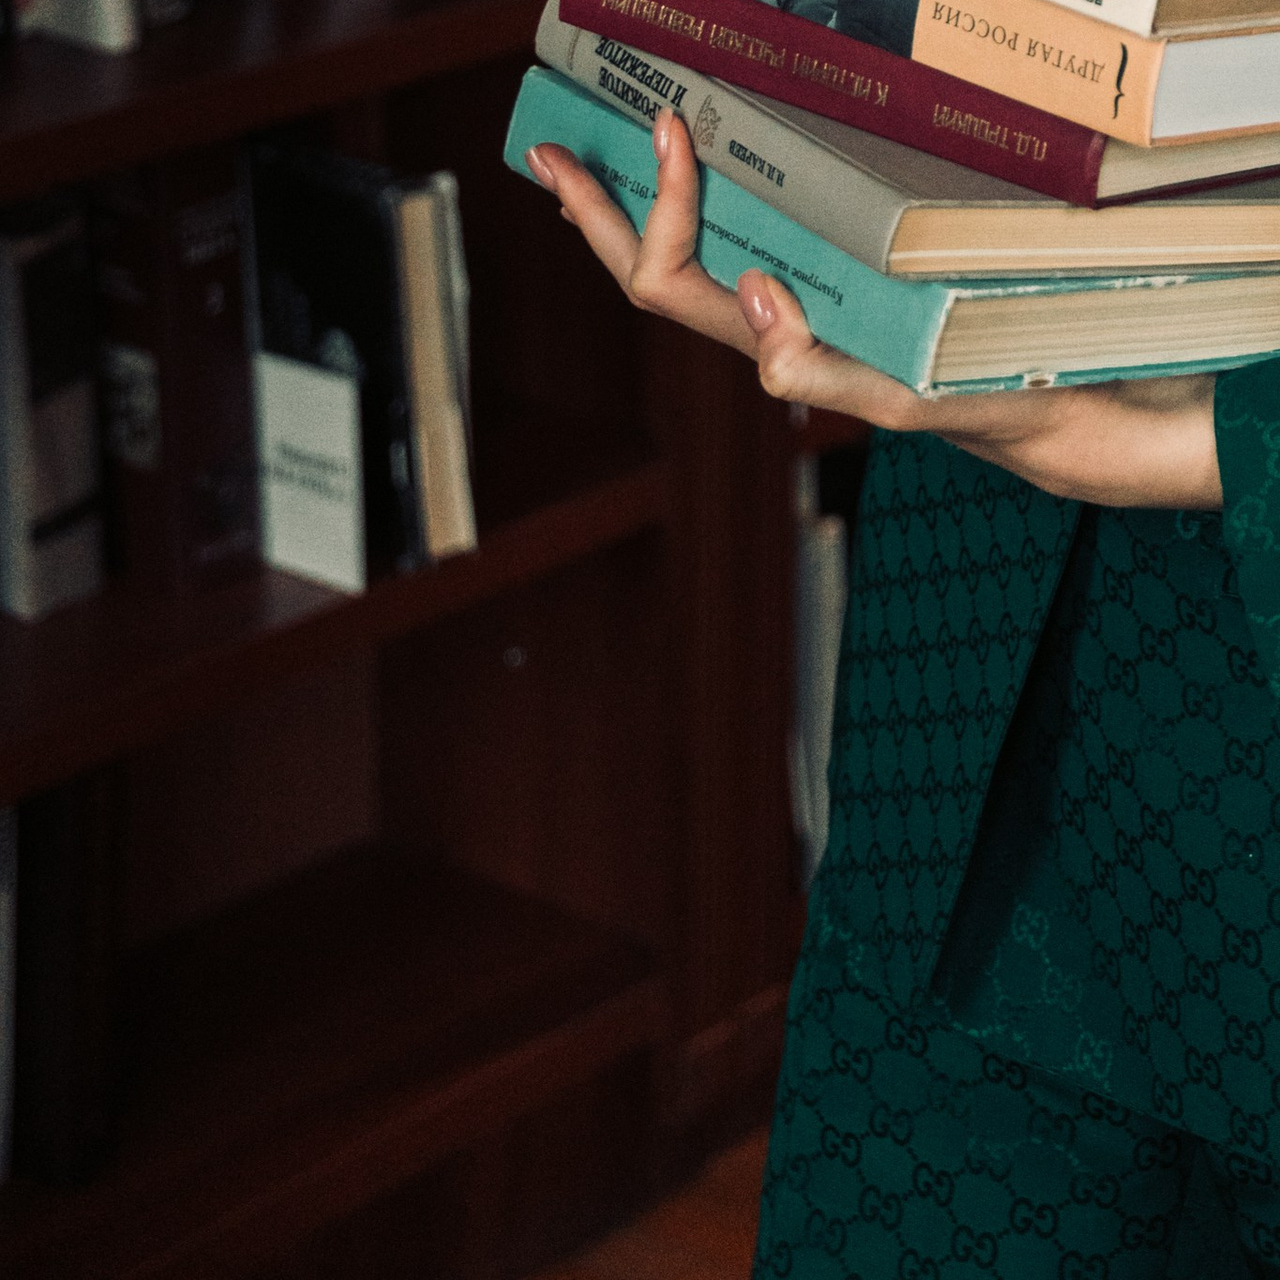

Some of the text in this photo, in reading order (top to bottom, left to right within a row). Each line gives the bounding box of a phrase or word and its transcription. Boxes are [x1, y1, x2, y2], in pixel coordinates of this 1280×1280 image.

[931, 1, 1106, 84] ДРУГАЯ РОССИЯ
[595, 37, 688, 108] И ПЕРЕЖИТОЕ
[609, 167, 650, 200] 1917-1940
[750, 244, 790, 277] наследие
[791, 266, 844, 307] Культурное
